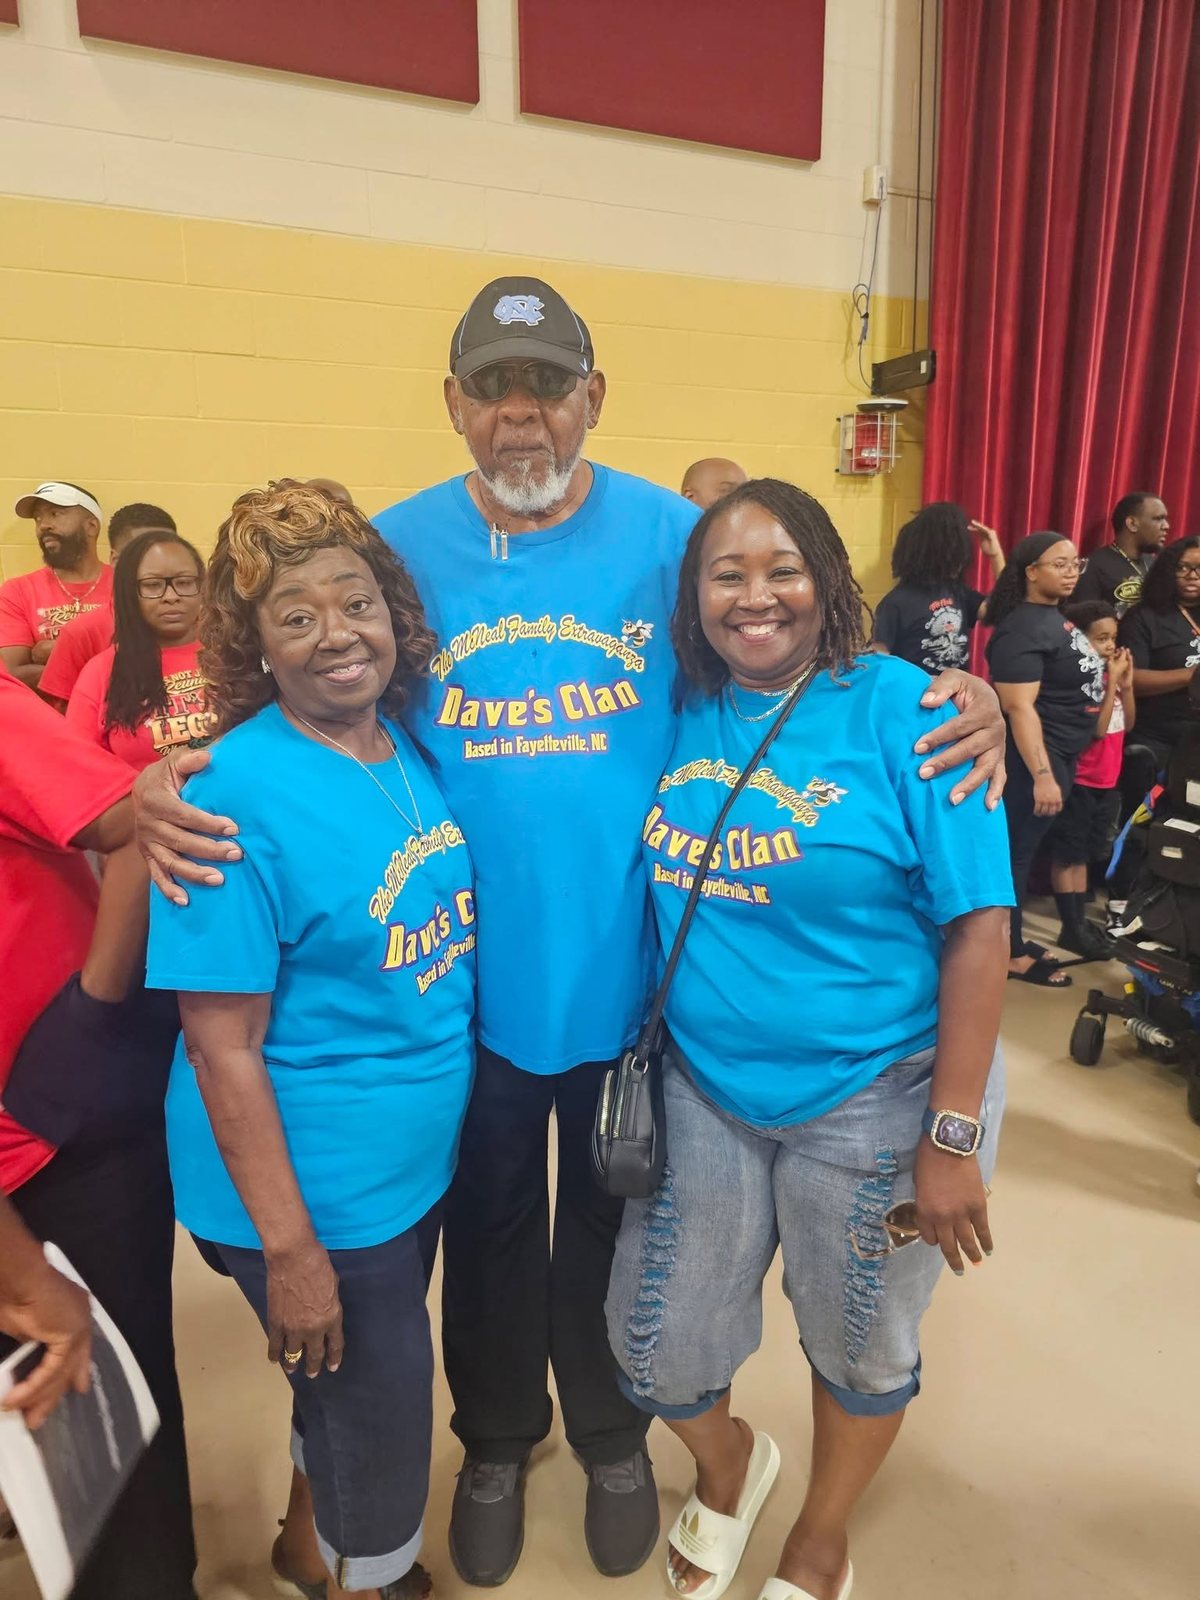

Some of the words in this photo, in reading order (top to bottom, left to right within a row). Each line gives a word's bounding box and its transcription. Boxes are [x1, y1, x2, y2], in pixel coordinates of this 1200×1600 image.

[430, 647, 453, 682] The
[450, 617, 506, 661] McNeal
[505, 614, 557, 644] Family
[557, 614, 645, 673] Extravaganza
[172, 669, 193, 682] NOT
[436, 686, 554, 728] Dave's
[558, 680, 641, 721] Clan
[464, 736, 498, 760] Based
[500, 737, 513, 756] in
[515, 733, 590, 758] Fayetteville,
[591, 732, 608, 752] NC
[726, 826, 801, 870] Clan
[682, 870, 693, 890] in
[699, 876, 755, 903] ayetteville,
[752, 884, 771, 905] NC
